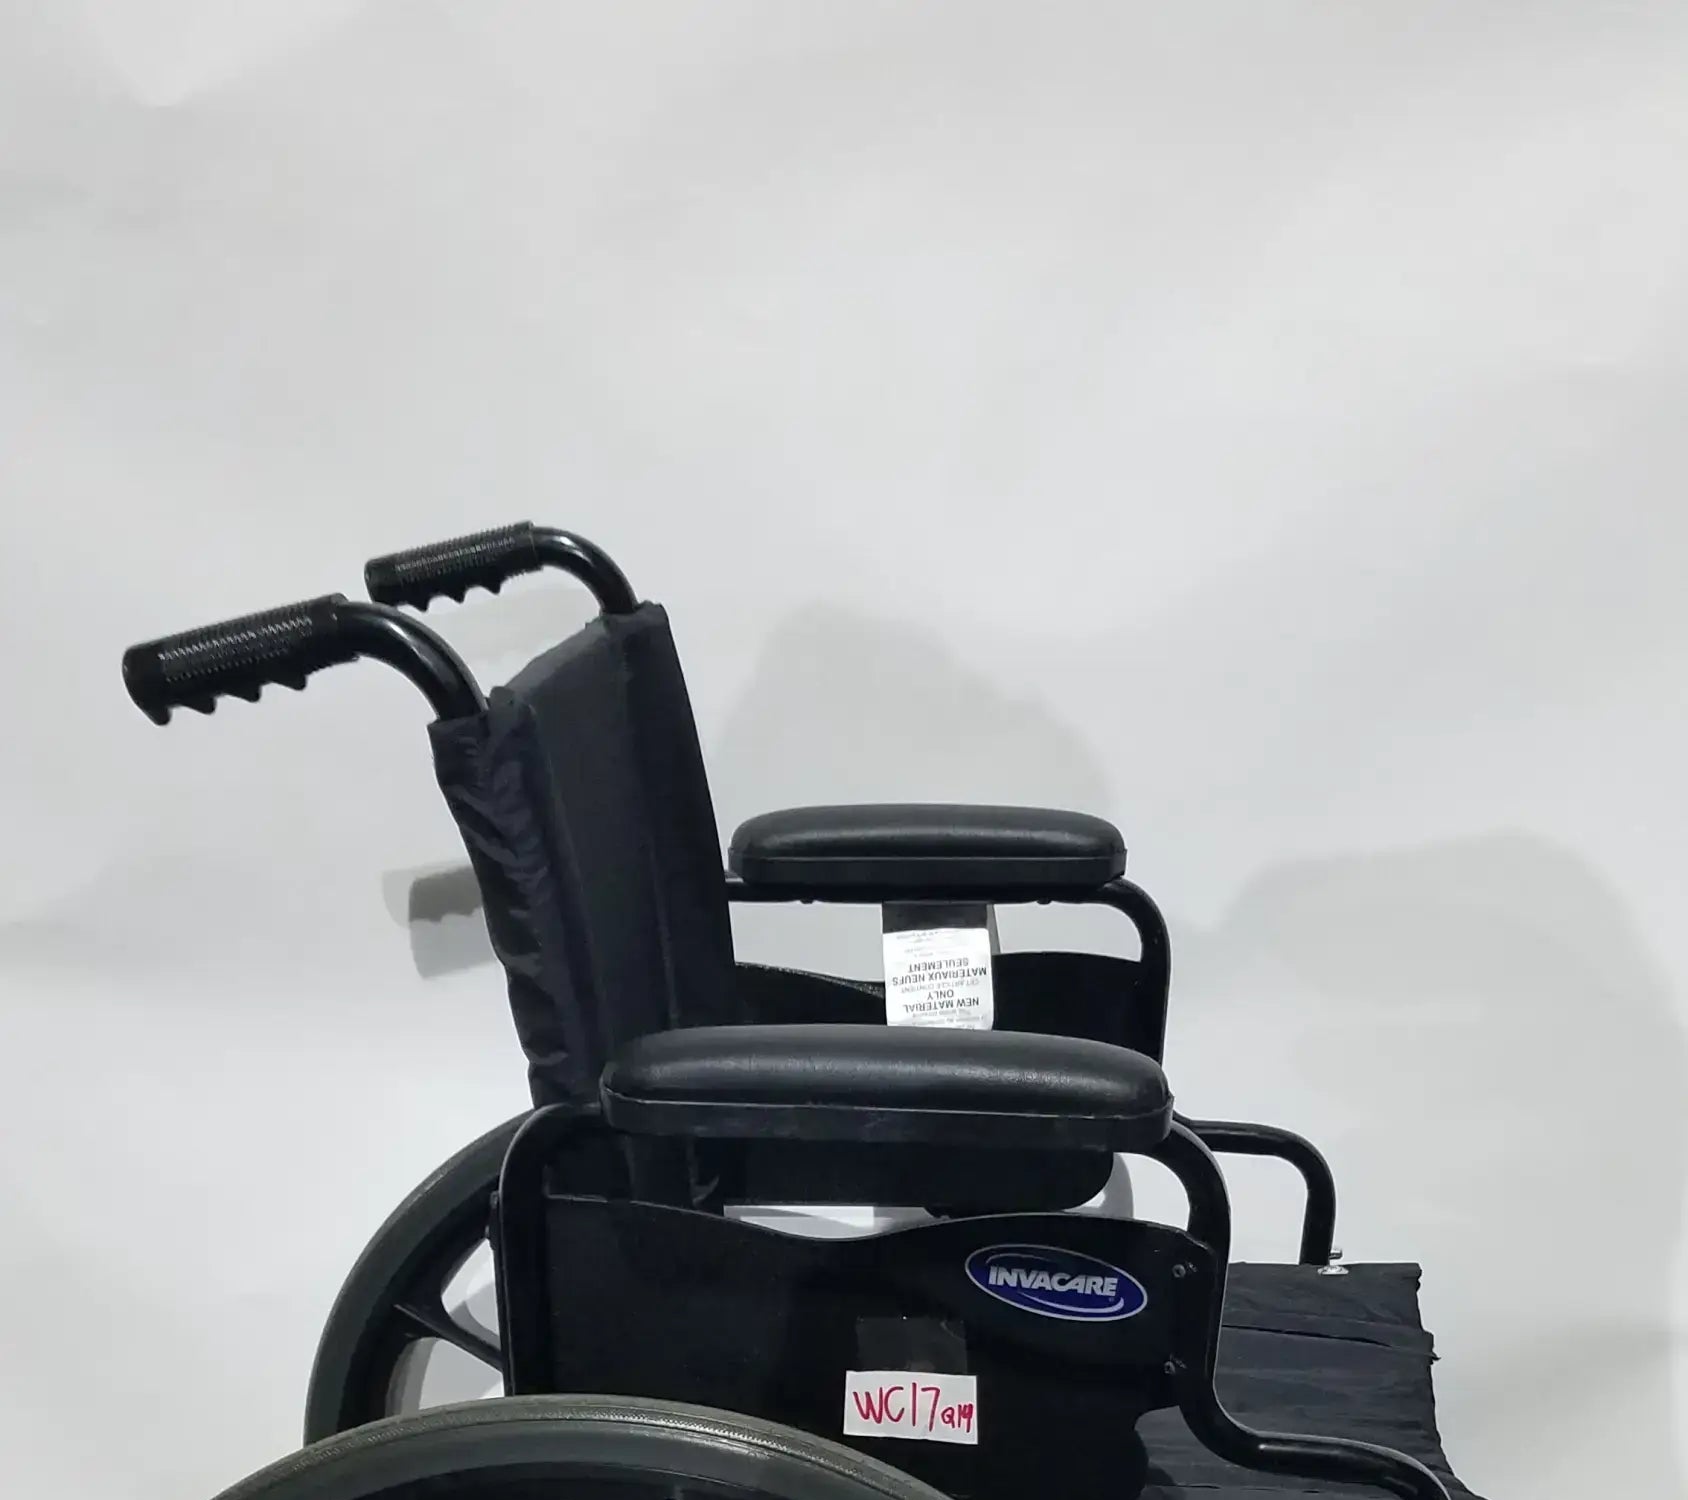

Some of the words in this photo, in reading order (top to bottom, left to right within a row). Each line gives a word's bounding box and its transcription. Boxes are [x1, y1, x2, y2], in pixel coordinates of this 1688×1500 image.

[909, 957, 968, 972] SEULEMENT
[892, 975, 925, 986] NEUFS
[927, 989, 954, 1000] ONLY
[903, 1000, 953, 1013] MATERIAL
[956, 997, 979, 1007] NEW
[988, 1266, 1118, 1297] INVACARE
